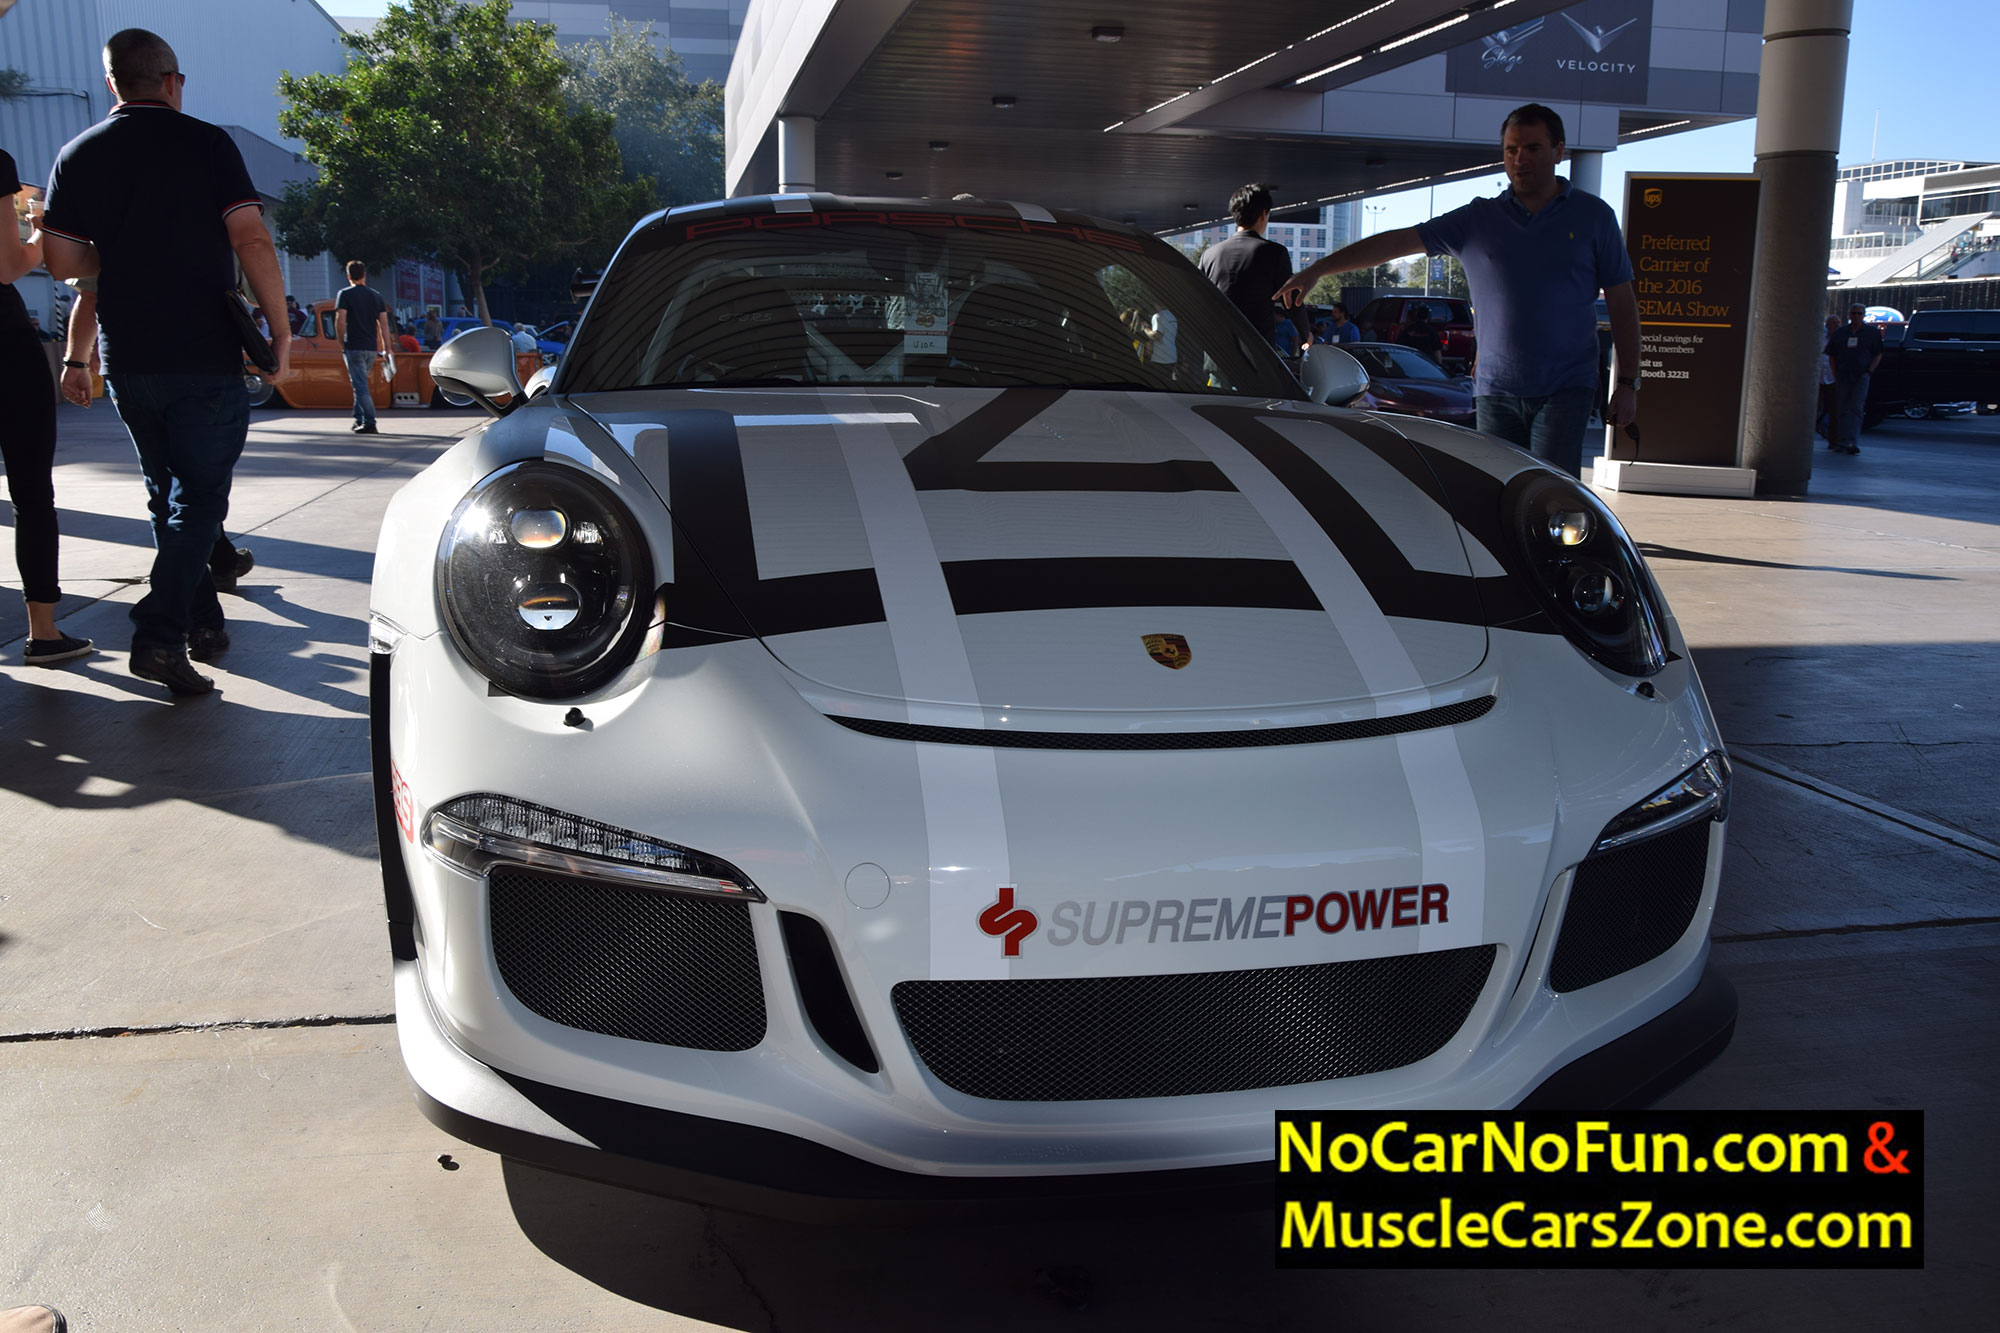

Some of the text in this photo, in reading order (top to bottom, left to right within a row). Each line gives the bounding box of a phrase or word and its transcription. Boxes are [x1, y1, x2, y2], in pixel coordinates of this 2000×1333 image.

[1481, 46, 1524, 72] Stage
[1557, 59, 1636, 73] VELOCITY
[686, 211, 1145, 253] PORSCHE
[1641, 234, 1711, 250] Preferred
[1640, 257, 1711, 273] Carrier of
[1638, 279, 1702, 295] the 2016
[1637, 300, 1730, 317] SEMA Show
[1640, 334, 1704, 344] pecial savings for
[1640, 344, 1695, 354] EMA members
[1641, 370, 1689, 379] Booth 32231
